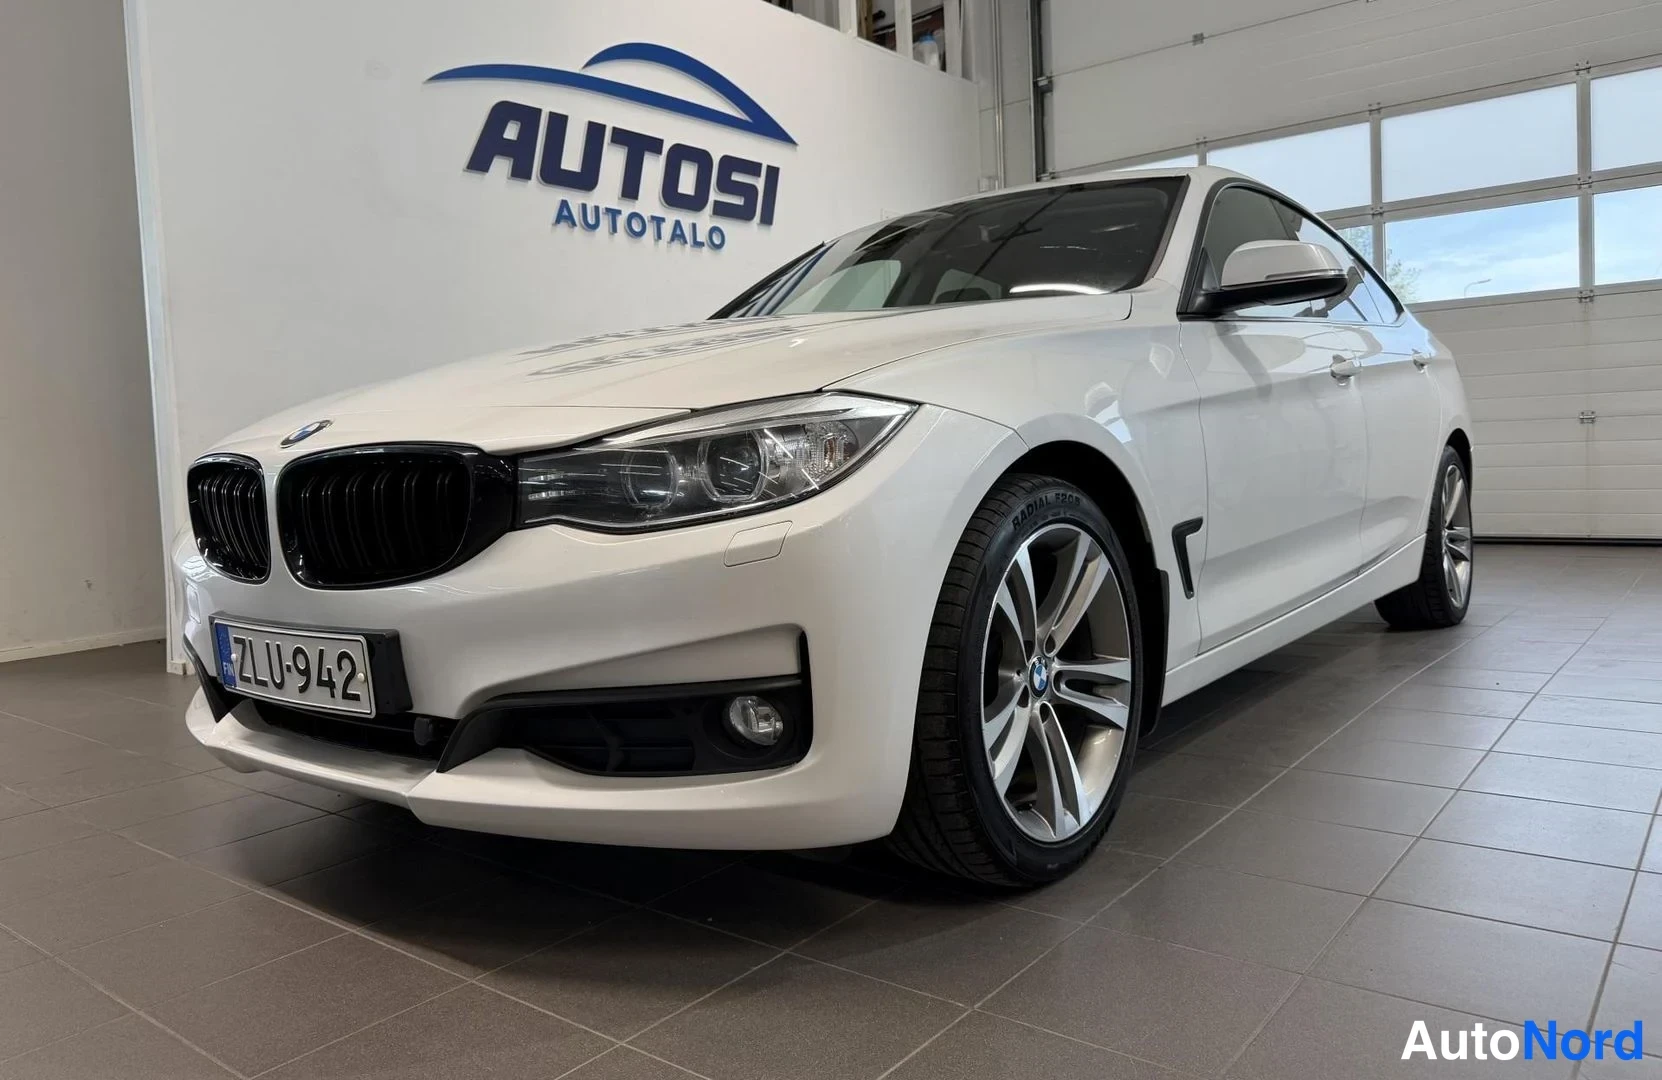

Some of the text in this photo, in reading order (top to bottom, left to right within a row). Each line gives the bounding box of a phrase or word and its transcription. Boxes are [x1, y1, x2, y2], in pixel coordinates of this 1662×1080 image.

[465, 100, 780, 226] AUTOSI
[554, 199, 726, 250] AUTOTALO
[1012, 496, 1050, 530] RADIAL
[232, 636, 361, 702] ZLU-942
